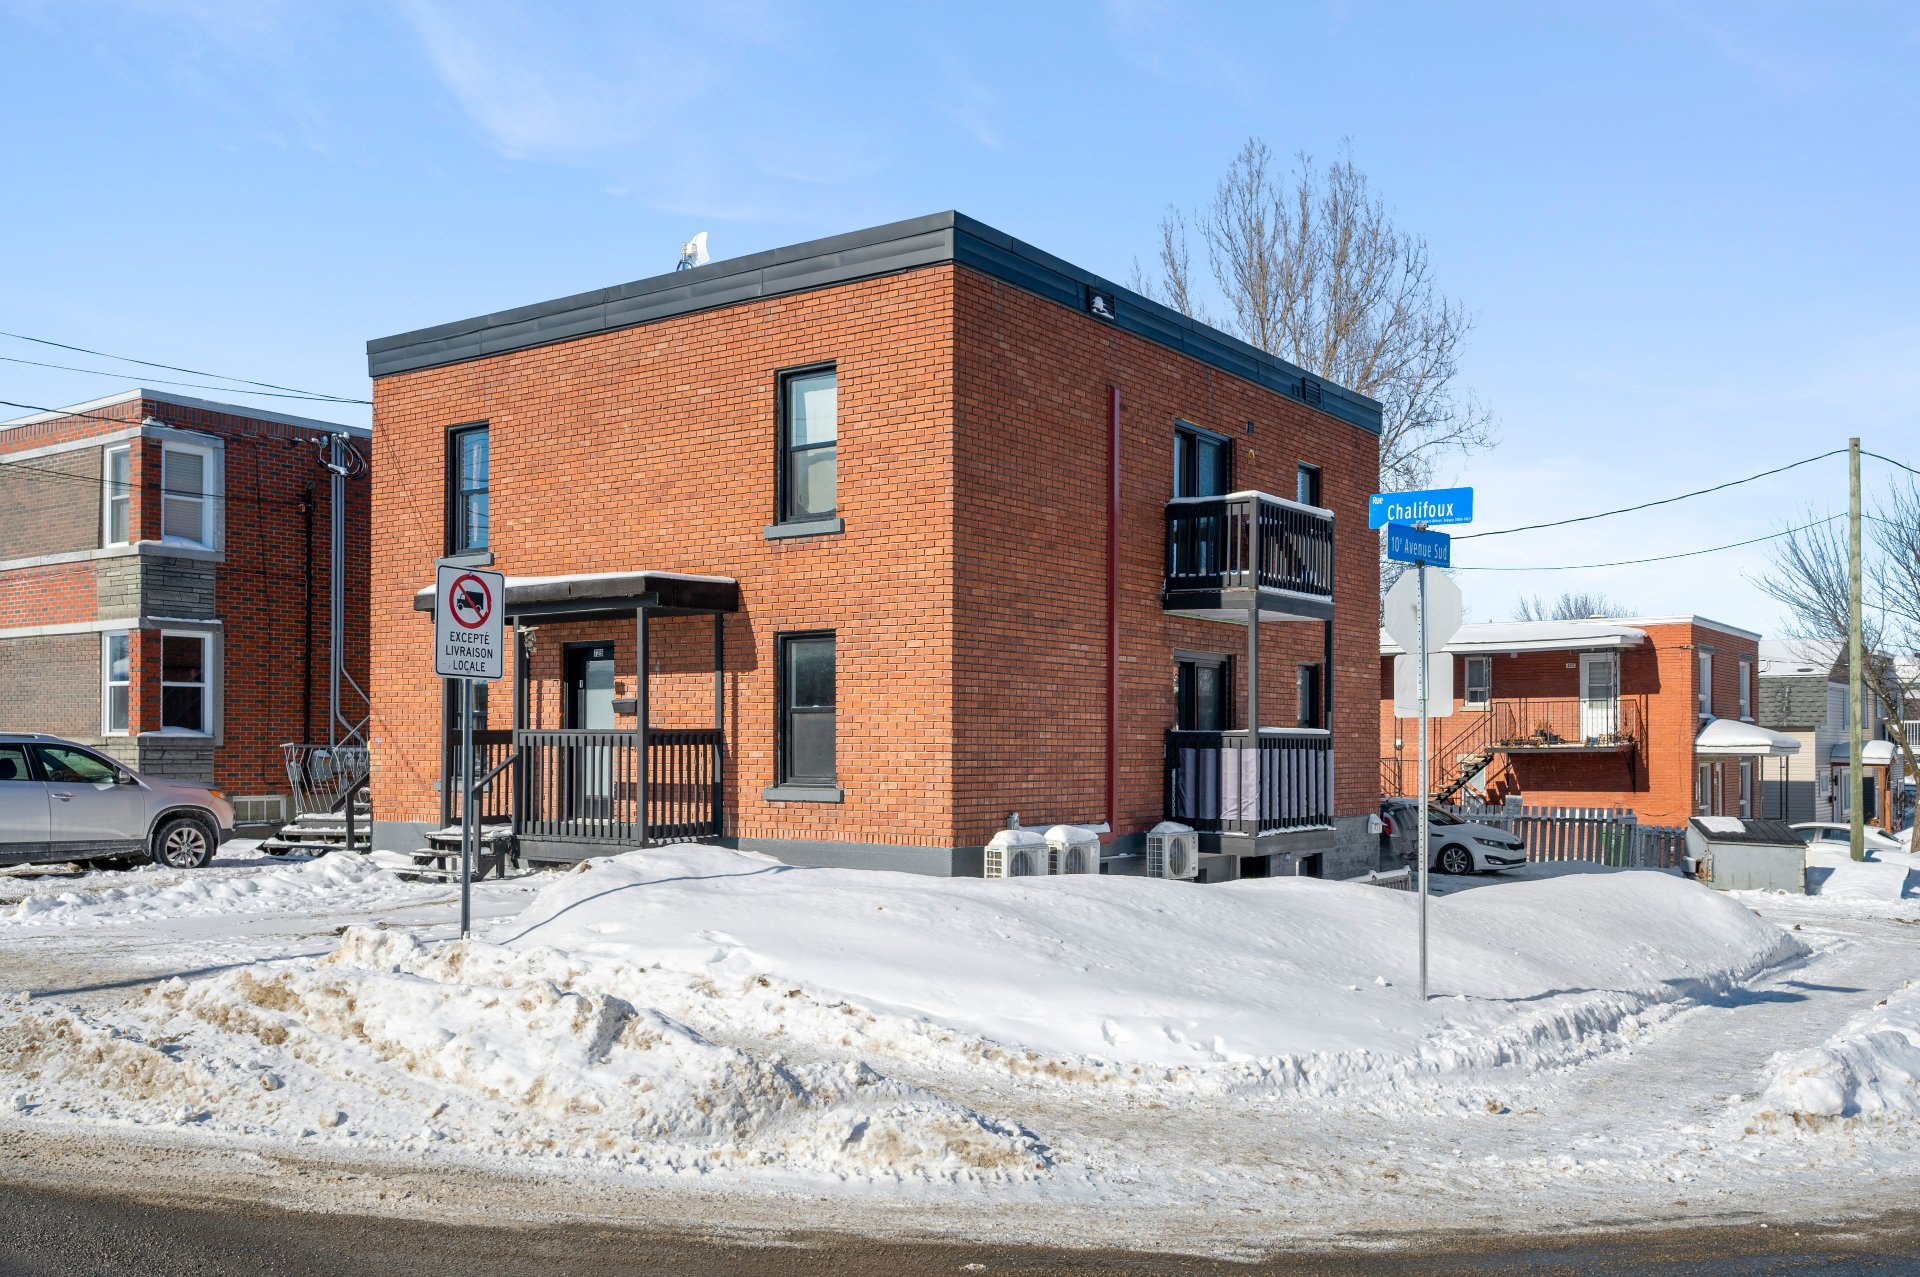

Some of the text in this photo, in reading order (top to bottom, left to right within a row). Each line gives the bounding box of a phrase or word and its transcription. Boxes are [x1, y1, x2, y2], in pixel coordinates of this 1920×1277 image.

[1372, 497, 1384, 505] Rue
[1387, 501, 1454, 520] Chalifoux
[1404, 538, 1431, 557] Avenue
[1434, 544, 1448, 560] Sud
[449, 631, 490, 645] EXCEPTÉ
[445, 645, 493, 659] LIVRAISON
[453, 660, 486, 672] LOCALE
